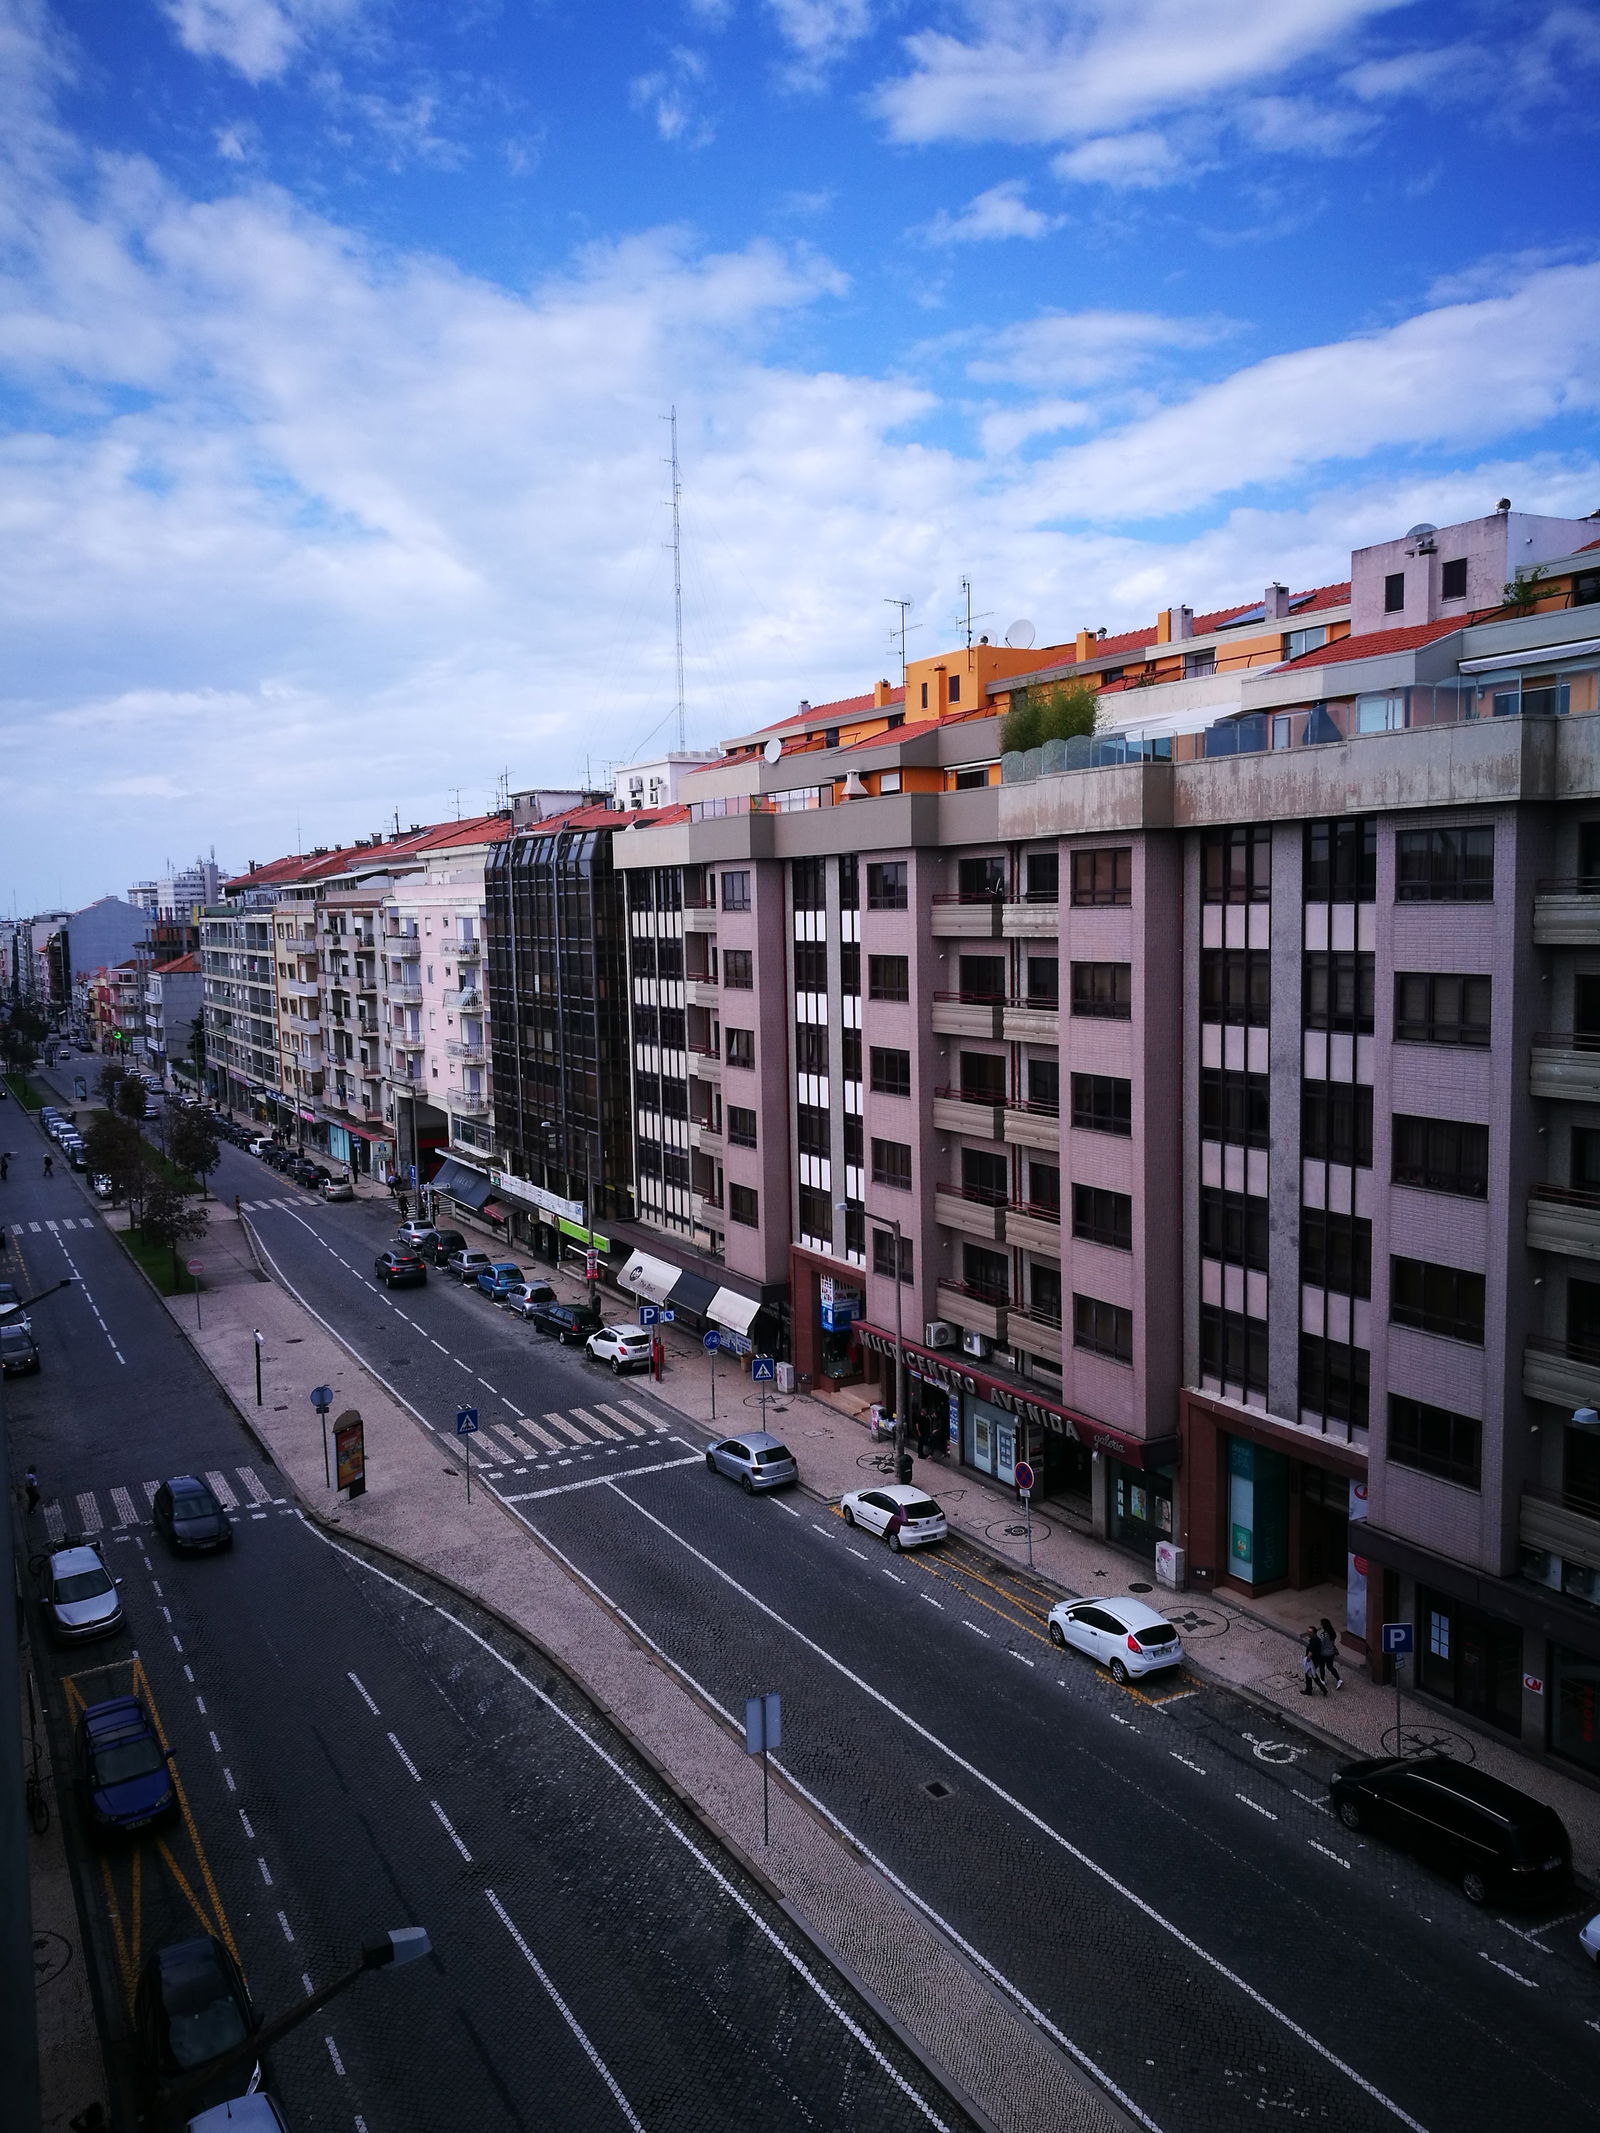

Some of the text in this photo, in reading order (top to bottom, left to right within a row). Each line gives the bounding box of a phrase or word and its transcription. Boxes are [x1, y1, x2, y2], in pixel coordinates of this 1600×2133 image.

[643, 1308, 655, 1324] P
[991, 1387, 1080, 1442] AVENIDA
[1094, 1434, 1126, 1454] galeria
[1390, 1628, 1405, 1648] P
